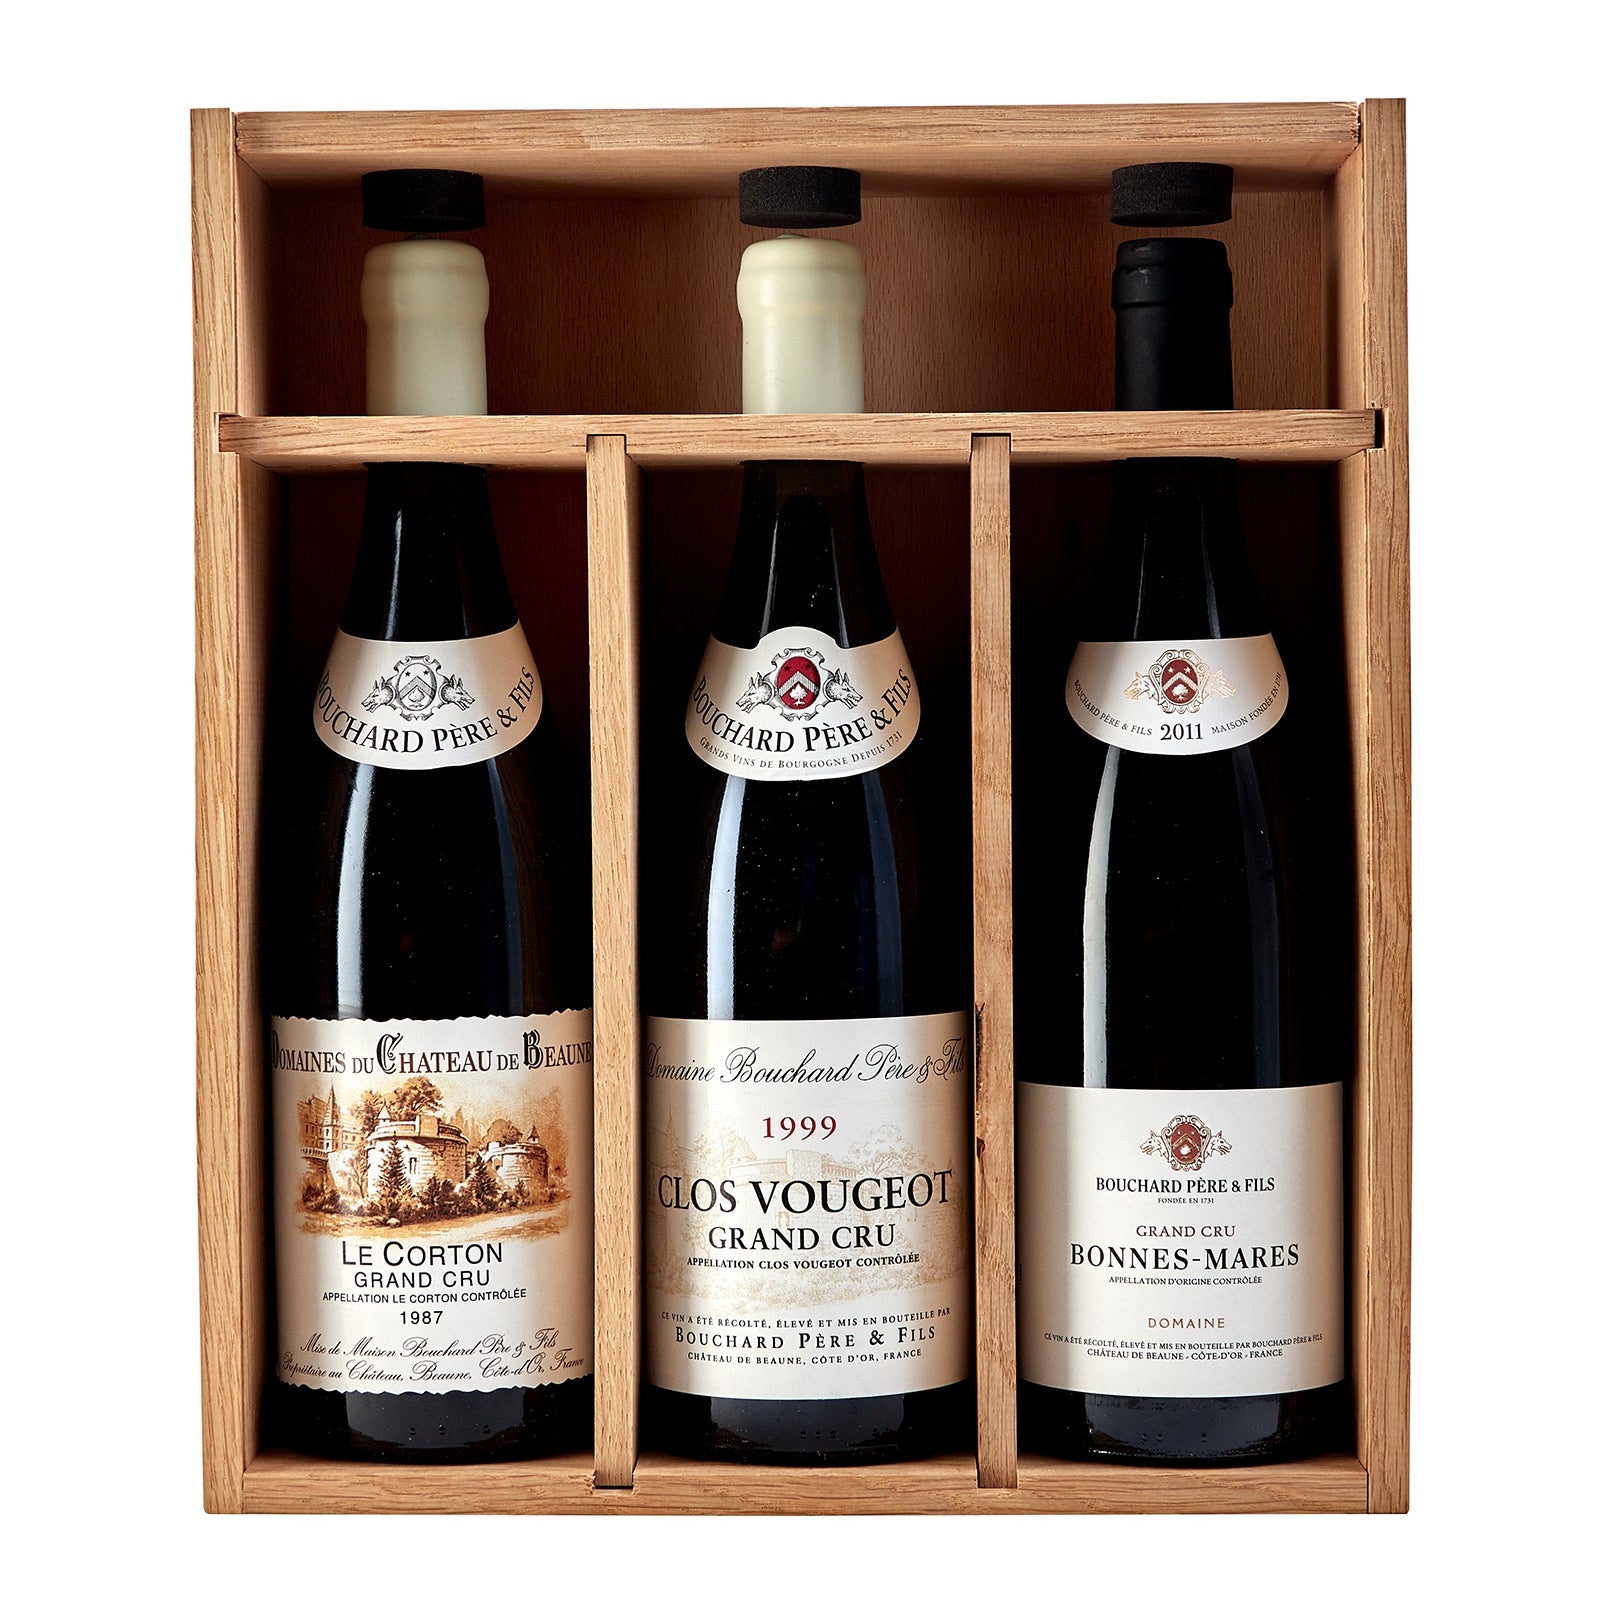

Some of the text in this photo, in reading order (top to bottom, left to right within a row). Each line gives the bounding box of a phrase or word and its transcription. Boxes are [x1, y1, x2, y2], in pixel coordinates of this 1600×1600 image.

[432, 717, 498, 752] PÈRE
[497, 708, 518, 728] &
[509, 666, 535, 713] FILS
[693, 668, 912, 753] BOUCHARD PÈRE & FILS
[1074, 679, 1100, 717] BOUCHARD
[1121, 723, 1129, 731] &
[1130, 725, 1153, 736] FILS
[1211, 716, 1248, 734] MAISON
[1248, 696, 1274, 720] FONDÉE
[1271, 685, 1279, 698] EN
[1160, 723, 1204, 741] 2011
[700, 731, 903, 769] GRANDS VINS DE BOURGOGNE DEPUIS 1731
[352, 1057, 374, 1074] DU
[376, 1032, 493, 1074] CHATEAU
[496, 1053, 519, 1071] DE
[523, 1029, 592, 1070] BEAUNE
[647, 1037, 965, 1084] Domaine Bouchard Père & Fils
[763, 1115, 837, 1141] 1999
[658, 1169, 953, 1214] CLOS VOUGEOT
[1096, 1177, 1275, 1193] BOUCHARD PÈRE & FILS
[708, 1223, 896, 1250] GRAND CRU
[1136, 1225, 1236, 1237] GRAND CRU
[342, 1241, 503, 1266] LE CORTON
[687, 1252, 920, 1270] APPELLATION CLOS VOUGEOT CONTRÔLÉE
[1070, 1243, 1300, 1270] BONNES-MARES
[354, 1269, 490, 1288] GRAND CRU
[1109, 1276, 1166, 1285] APPELLATION
[1213, 1276, 1263, 1285] CONTRÔLÉE
[322, 1288, 527, 1304] APPELLATION LE CORTON CONTRÔLÉE
[399, 1310, 443, 1325] 1987
[662, 1311, 669, 1320] CE
[672, 1313, 685, 1323] VIN
[688, 1316, 693, 1324] A
[696, 1315, 713, 1326] ÉTÉ
[776, 1318, 813, 1328] ÉLEVÉ
[819, 1319, 832, 1328] ET
[838, 1317, 858, 1327] MIS
[863, 1316, 877, 1326] EN
[882, 1310, 935, 1324] BOUTEILLE
[938, 1307, 951, 1317] PAR
[1148, 1318, 1225, 1328] DOMAINE
[300, 1333, 326, 1354] Mise
[328, 1341, 341, 1355] de
[343, 1336, 396, 1357] Maison
[400, 1337, 482, 1358] Bouchard
[511, 1341, 527, 1358] &
[529, 1327, 560, 1350] Fils
[676, 1325, 935, 1349] BOUCHARD PÈRE & FILS
[1044, 1332, 1052, 1340] CE
[1052, 1334, 1063, 1342] VIN
[1070, 1335, 1082, 1345] ÉTÉ
[1120, 1340, 1145, 1349] ÉLEVÉ
[1147, 1342, 1158, 1350] ET
[1188, 1342, 1234, 1350] BOUTEILLE
[1235, 1342, 1251, 1350] PAR
[1252, 1338, 1292, 1349] BOUCHARD
[1312, 1333, 1323, 1342] FILS
[328, 1371, 343, 1379] au
[345, 1359, 404, 1381] Château,
[409, 1360, 472, 1381] Beaune,
[549, 1348, 585, 1371] France
[688, 1348, 922, 1366] CHÂTEAU DE BEAUNE, CÔTE D'OR, FRANCE
[1087, 1348, 1129, 1359] CHÂTEAU
[1131, 1351, 1144, 1359] DE
[1146, 1352, 1184, 1360] BEAUNE
[1249, 1349, 1283, 1359] FRANCE
